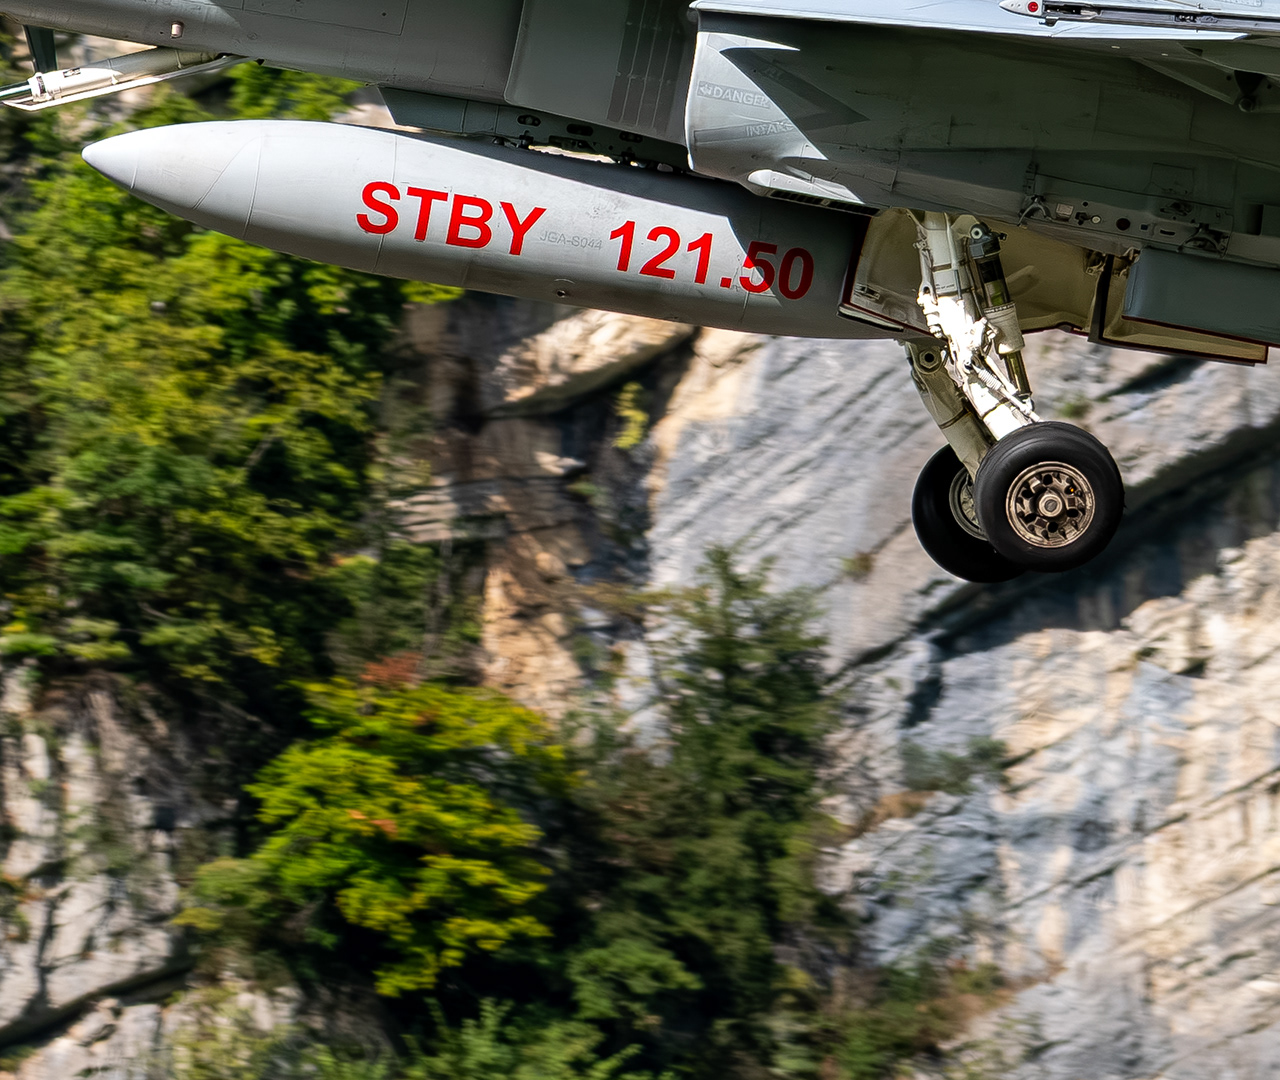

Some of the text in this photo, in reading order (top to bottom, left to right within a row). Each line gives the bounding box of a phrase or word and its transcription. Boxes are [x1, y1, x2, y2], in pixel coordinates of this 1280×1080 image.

[712, 85, 771, 108] DANGER
[355, 180, 815, 301] STBY 121.50
